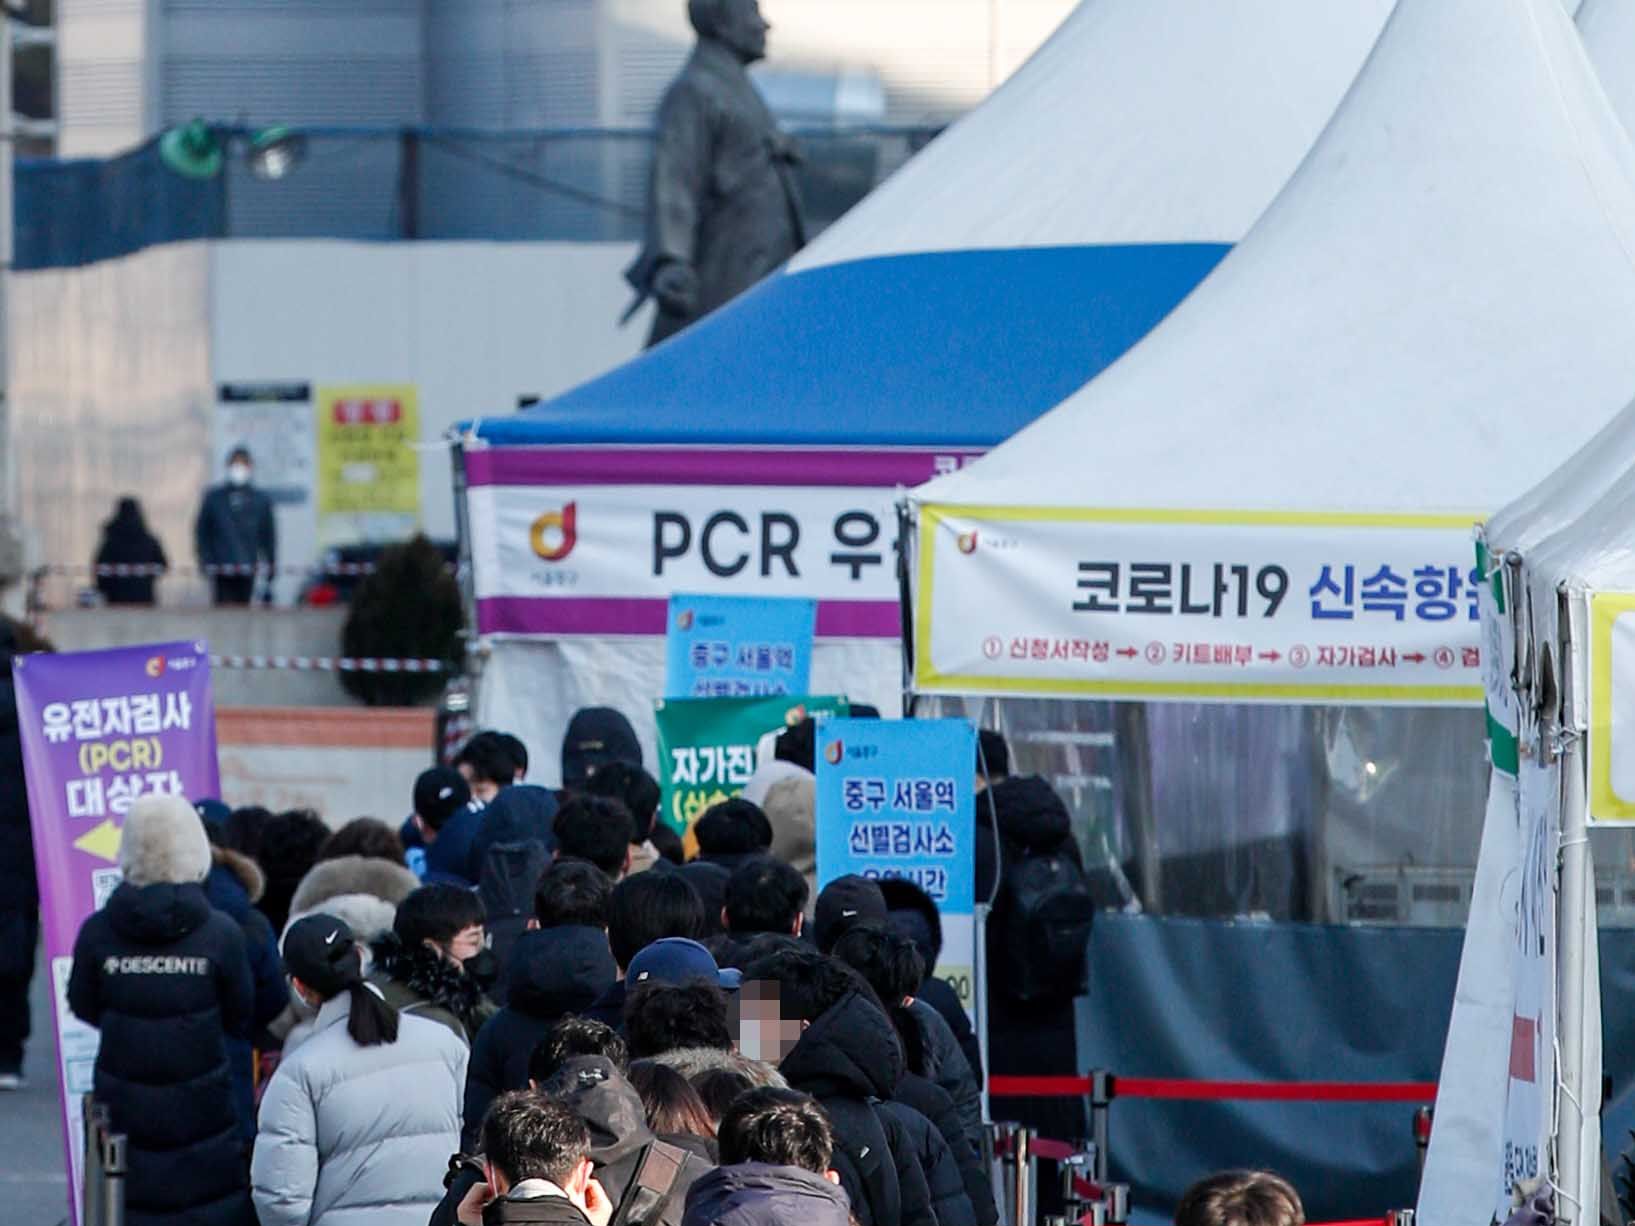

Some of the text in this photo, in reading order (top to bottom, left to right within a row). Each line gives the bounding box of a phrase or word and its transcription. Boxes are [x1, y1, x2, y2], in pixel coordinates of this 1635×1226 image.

[652, 510, 902, 580] PCR 우
[1072, 561, 1290, 618] 코로나19
[1010, 637, 1110, 663] 신청서작성
[1173, 642, 1253, 667] 키트배부
[1316, 645, 1397, 668] 자가검사
[42, 691, 193, 743] 유전자검사
[78, 736, 163, 775] (PCR)
[844, 780, 955, 811] 중구 서울역
[849, 824, 955, 856] 선별검사소
[120, 955, 209, 976] DESCENTE
